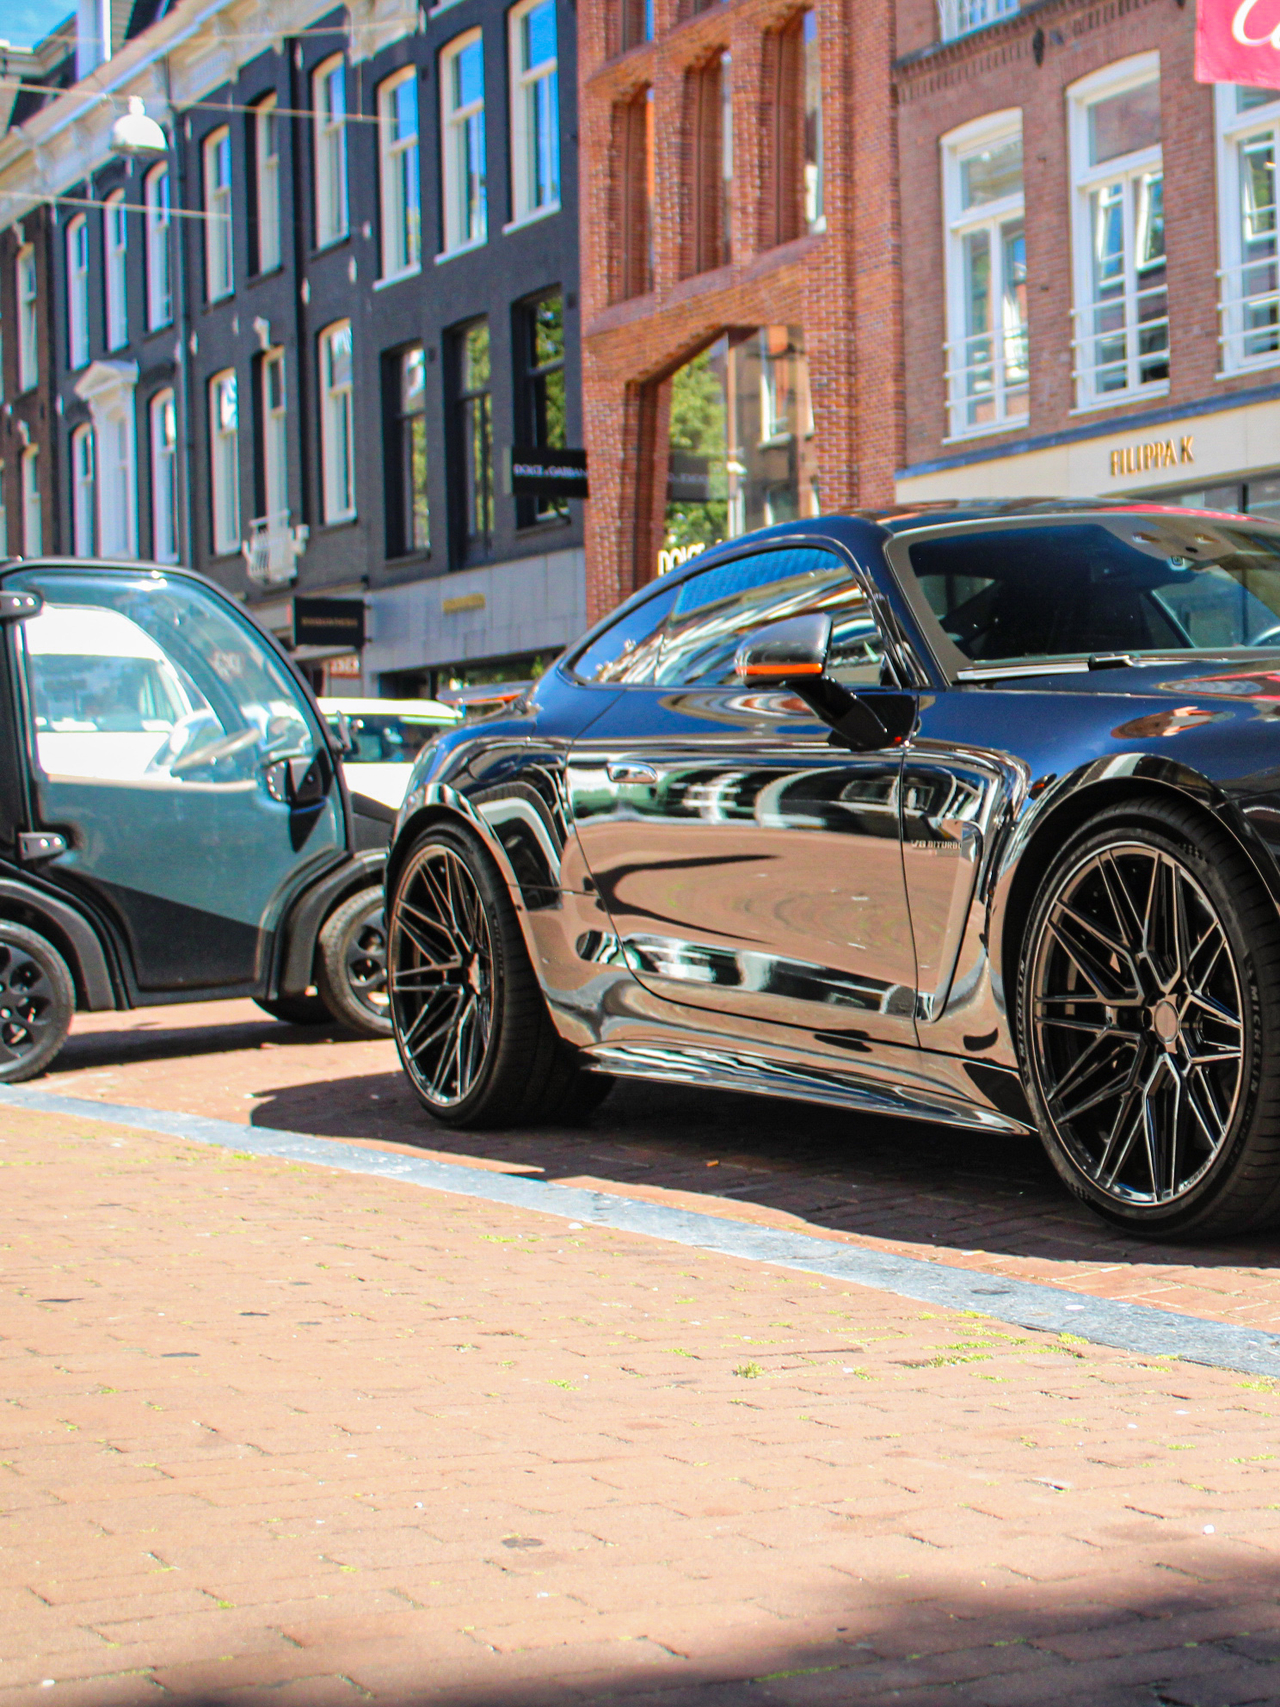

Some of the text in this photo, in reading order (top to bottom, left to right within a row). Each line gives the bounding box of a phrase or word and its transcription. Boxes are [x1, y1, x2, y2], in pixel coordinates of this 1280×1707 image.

[1110, 436, 1195, 477] FILIPPA K
[1250, 984, 1262, 1093] MICHELIN
